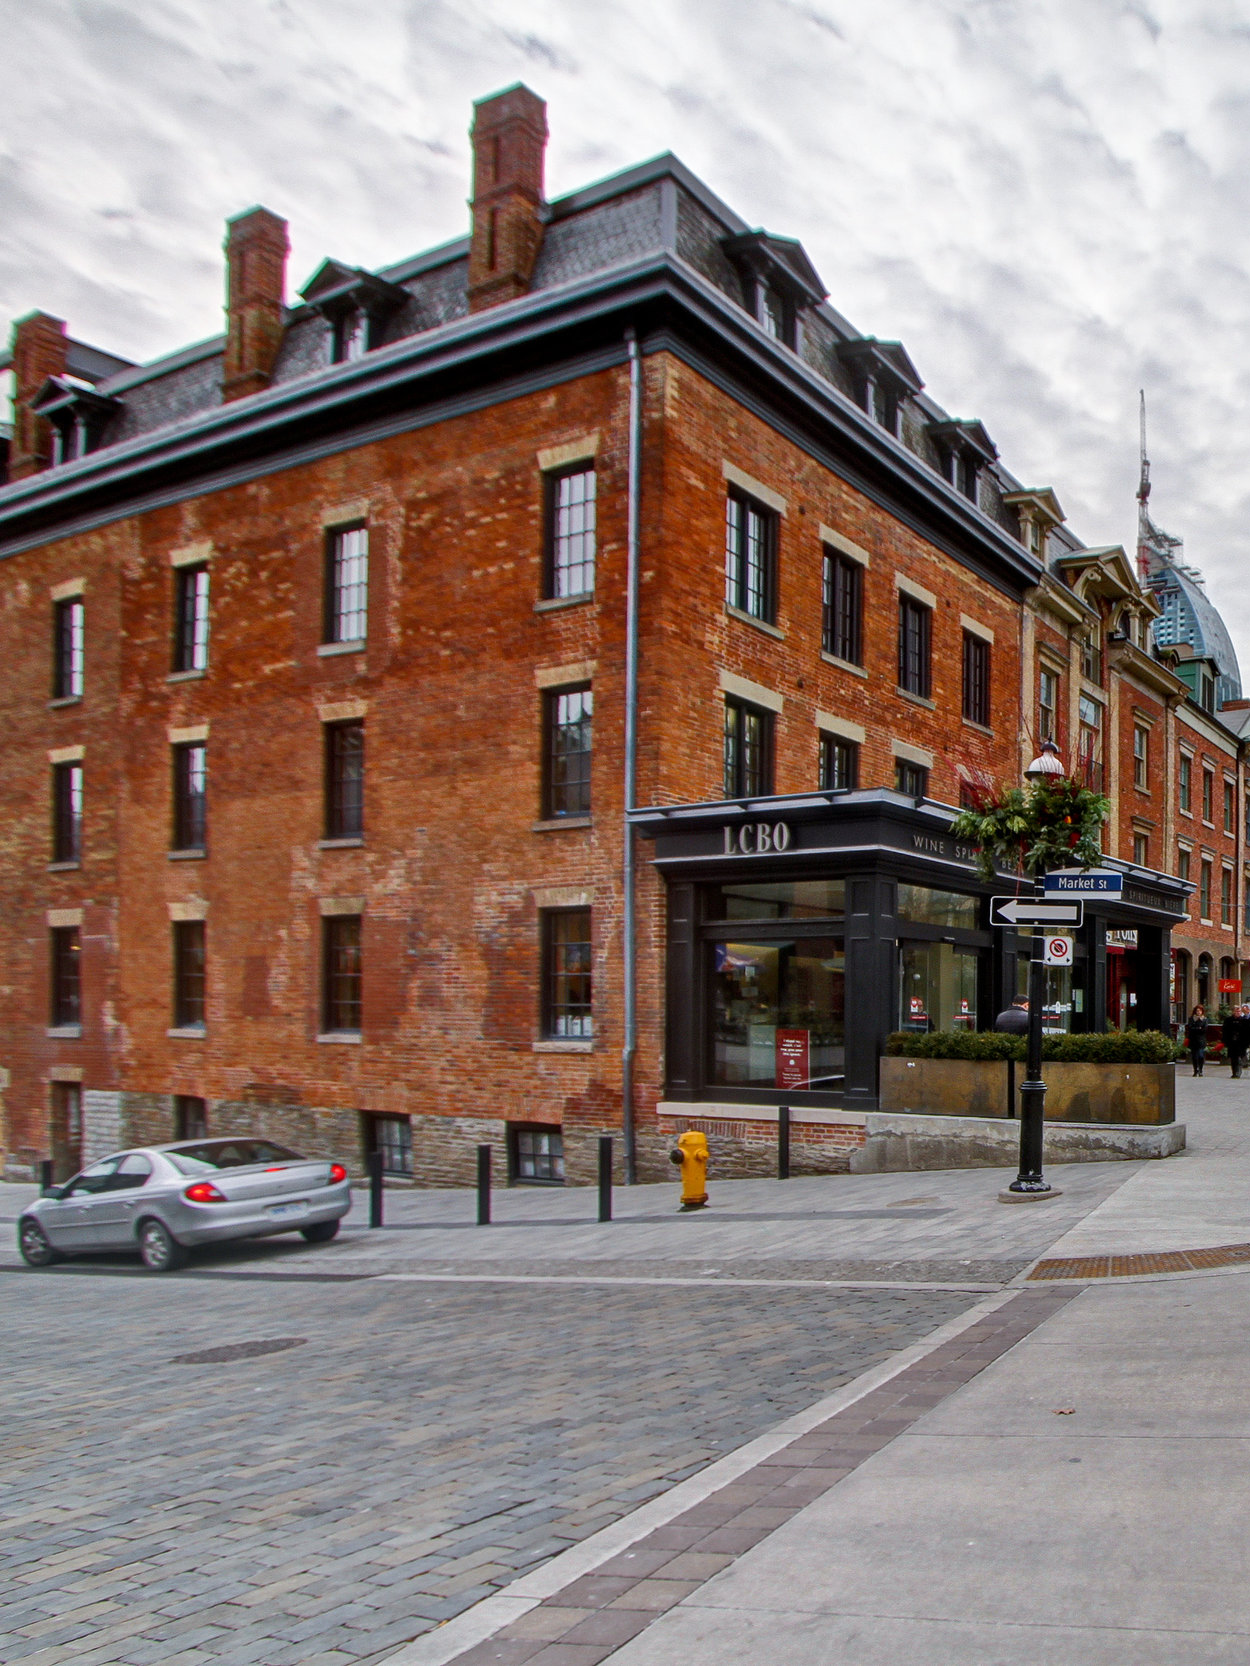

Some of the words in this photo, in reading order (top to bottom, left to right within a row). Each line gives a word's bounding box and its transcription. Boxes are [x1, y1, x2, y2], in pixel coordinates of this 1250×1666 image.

[723, 821, 789, 854] LCBO
[913, 834, 944, 854] WINE
[1058, 877, 1095, 889] Market
[1098, 879, 1107, 889] St
